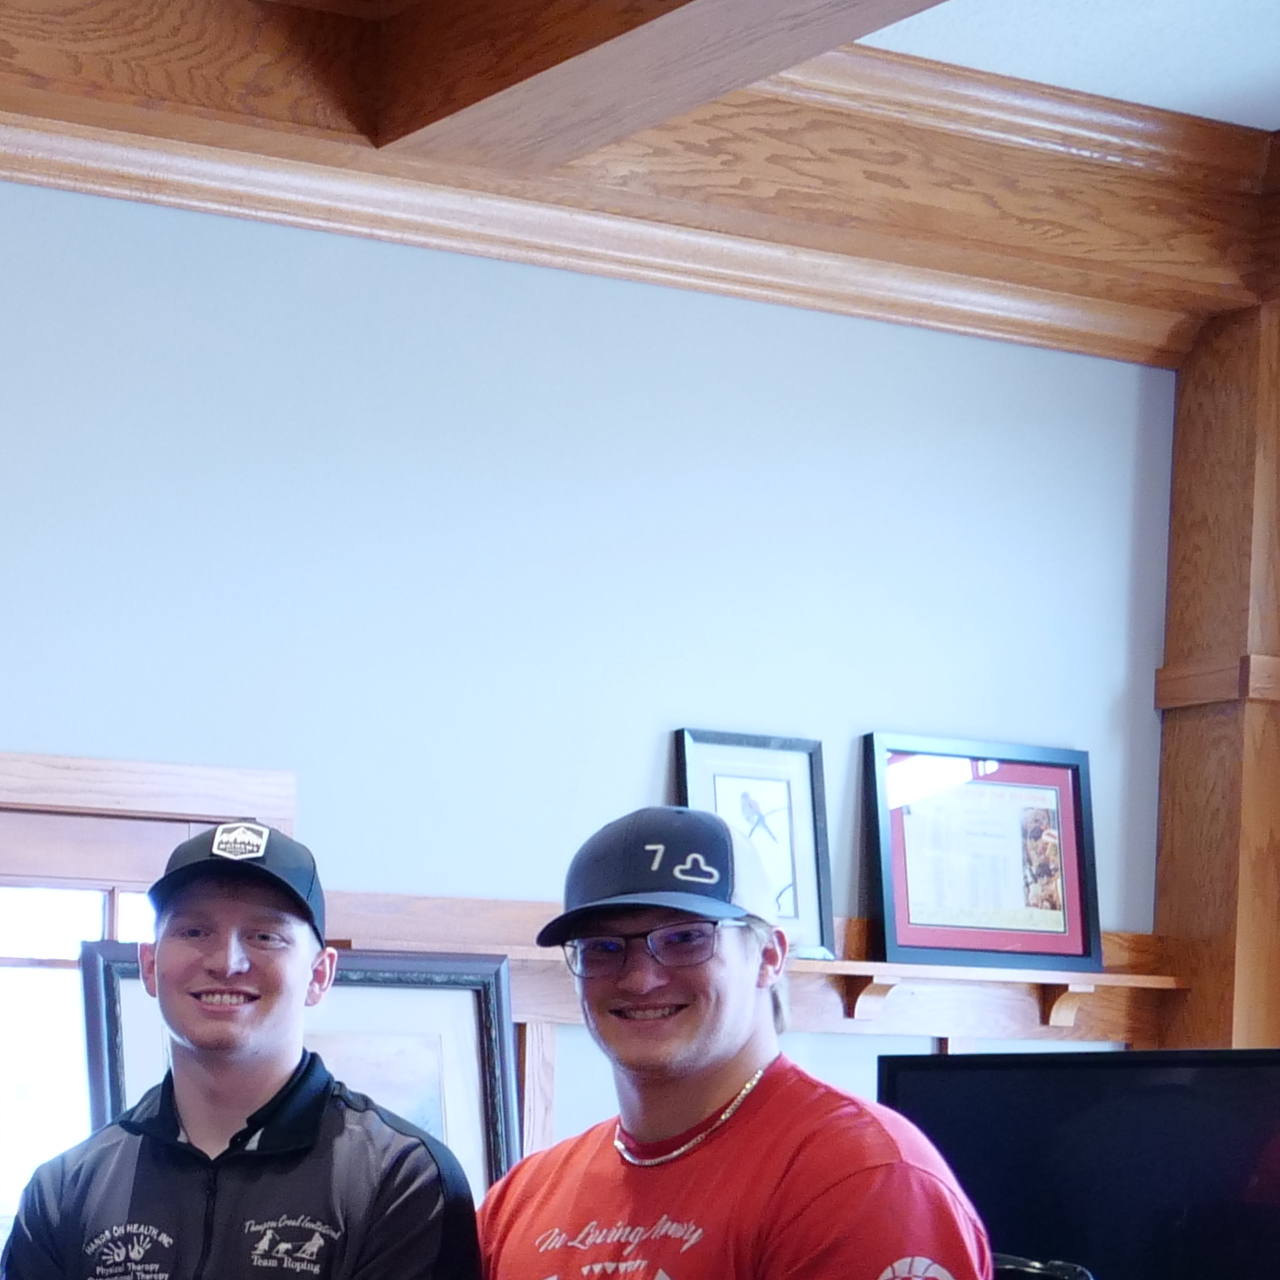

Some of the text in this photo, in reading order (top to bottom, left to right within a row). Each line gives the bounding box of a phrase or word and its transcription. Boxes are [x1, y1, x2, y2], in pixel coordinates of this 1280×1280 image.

[644, 844, 665, 871] 7
[85, 1229, 111, 1256] HANDS
[112, 1224, 125, 1237] ON
[535, 1227, 567, 1253] In
[567, 1220, 646, 1256] Loving
[96, 1262, 160, 1276] Physical Therapy
[251, 1254, 321, 1275] Team Roping
